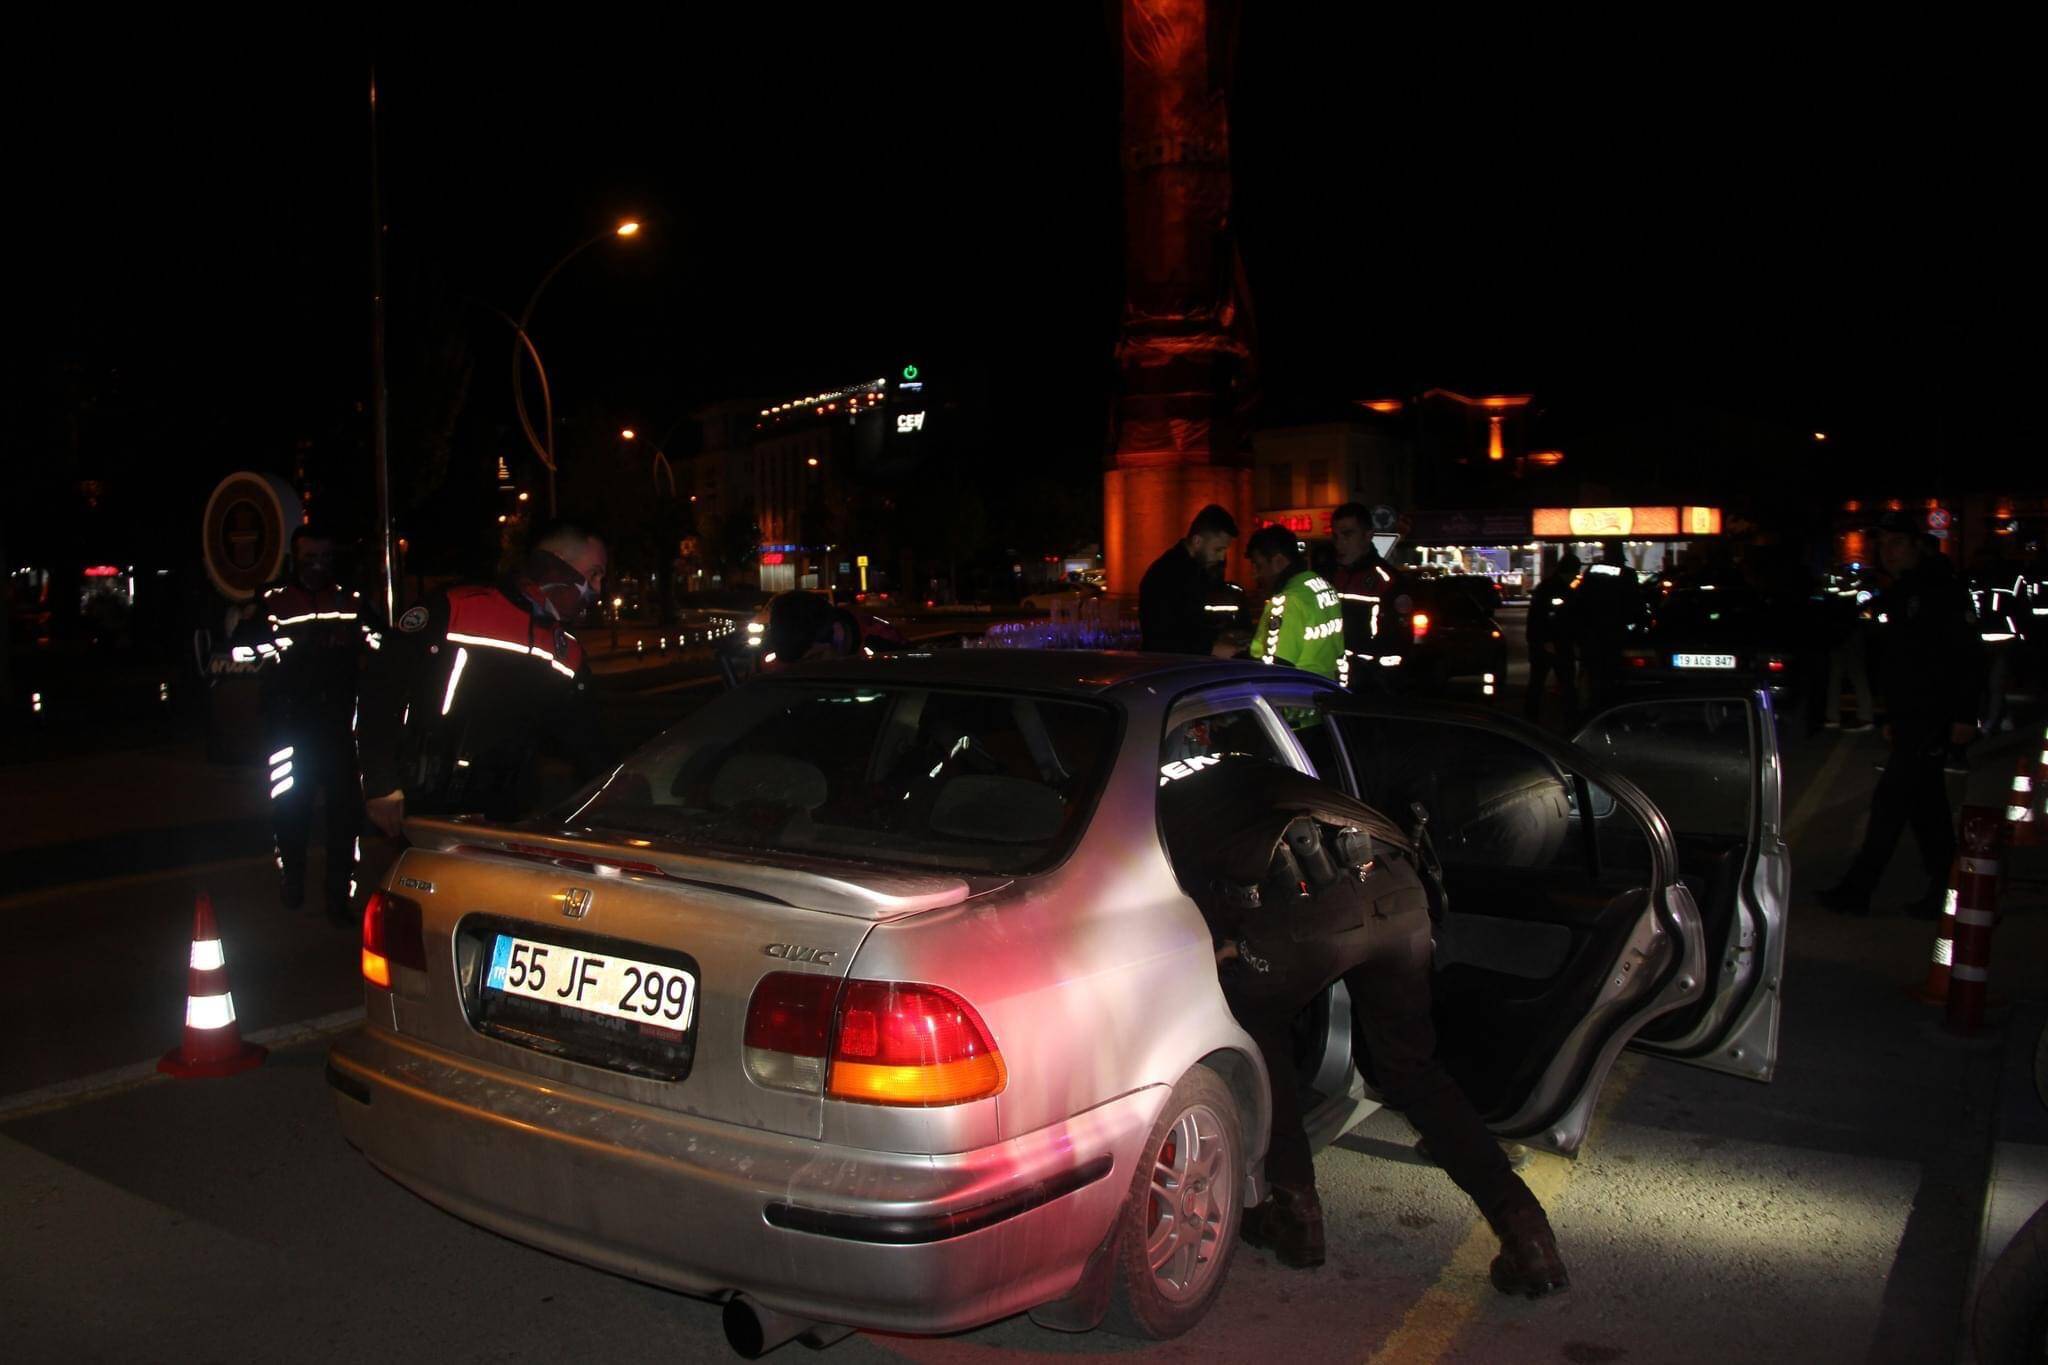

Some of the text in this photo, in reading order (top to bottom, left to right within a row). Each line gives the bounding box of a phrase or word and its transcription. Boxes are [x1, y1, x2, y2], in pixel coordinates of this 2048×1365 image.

[765, 943, 838, 966] CIVIC
[509, 943, 687, 1020] 55 JF 299
